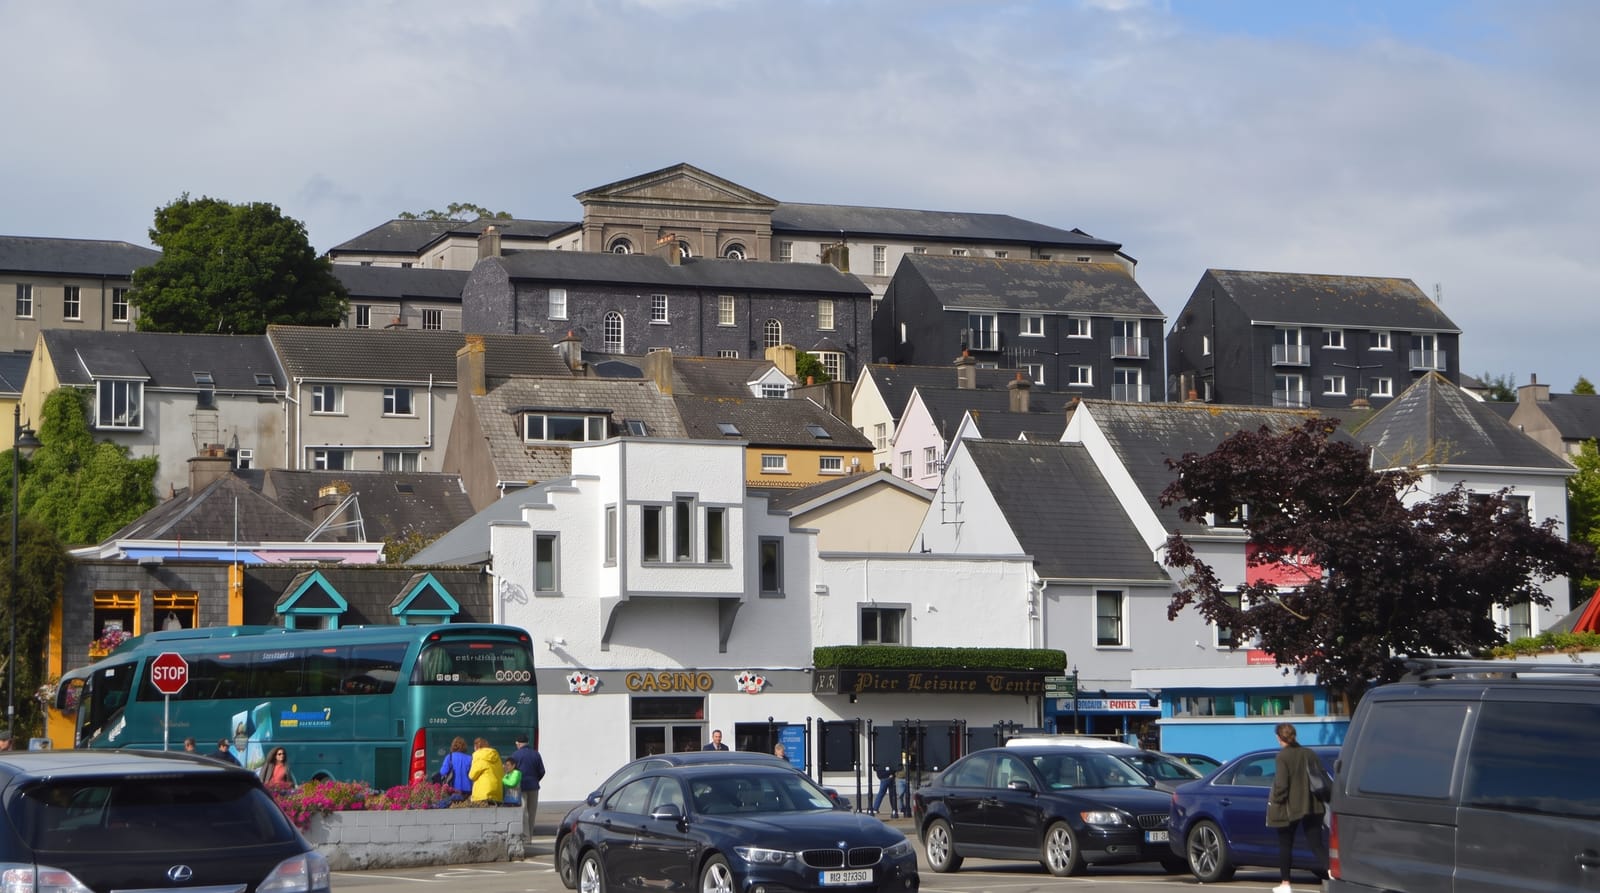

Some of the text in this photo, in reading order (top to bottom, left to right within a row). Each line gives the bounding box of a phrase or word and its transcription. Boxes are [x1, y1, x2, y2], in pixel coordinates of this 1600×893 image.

[153, 666, 186, 680] STOP
[625, 672, 713, 691] CASINO
[853, 672, 900, 692] Pier
[907, 672, 977, 691] Leisure
